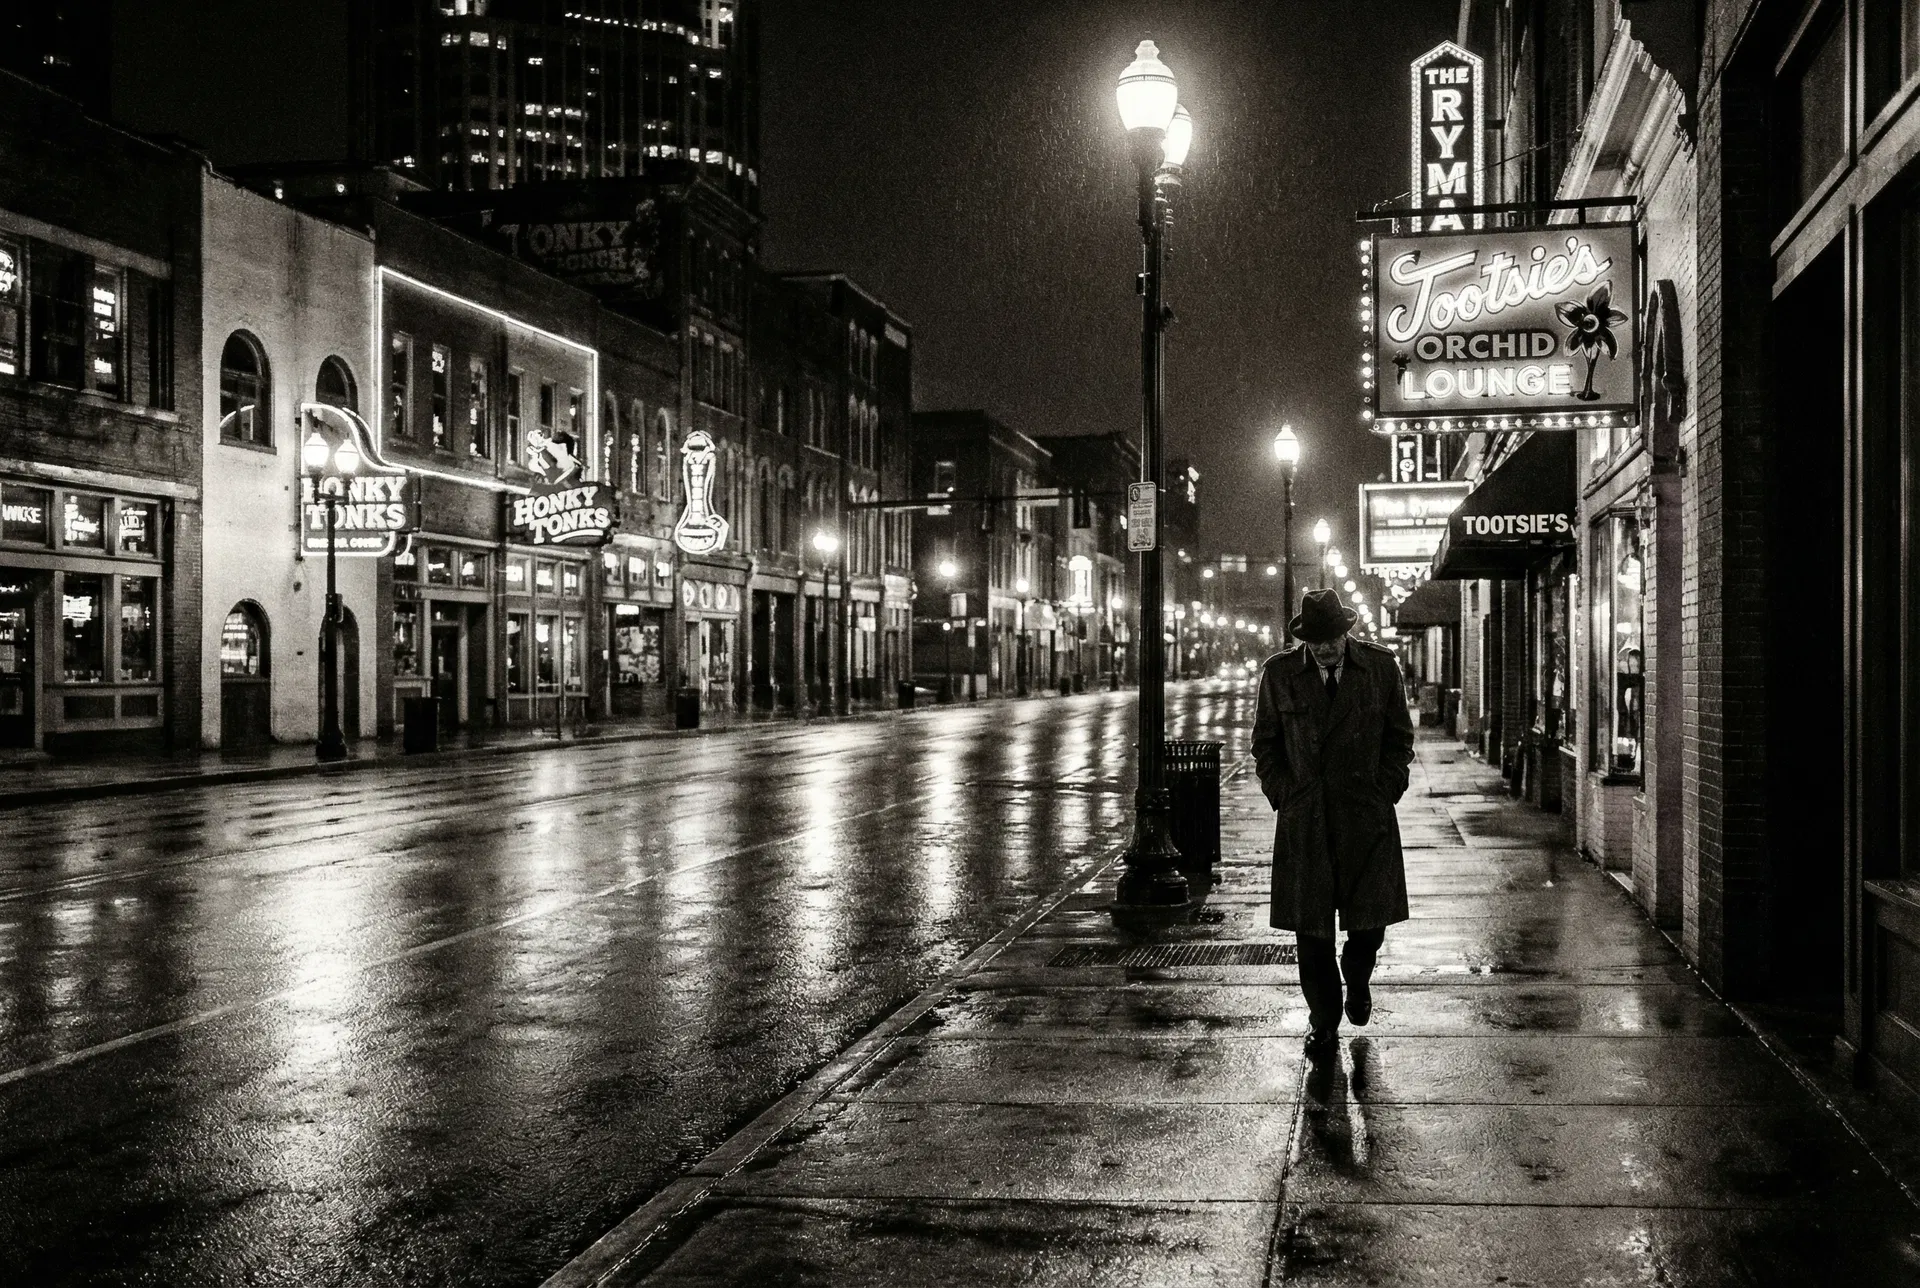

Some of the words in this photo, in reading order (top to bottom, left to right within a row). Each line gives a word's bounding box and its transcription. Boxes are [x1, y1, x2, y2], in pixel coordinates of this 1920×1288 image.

[1425, 67, 1469, 85] THE
[1386, 236, 1612, 342] Tootsie's
[1416, 332, 1556, 360] ORCHID
[1403, 363, 1573, 399] LOUNGE
[513, 486, 599, 526] HONKY
[1463, 513, 1569, 535] TOOTSIE'S
[529, 507, 611, 544] TONKS
